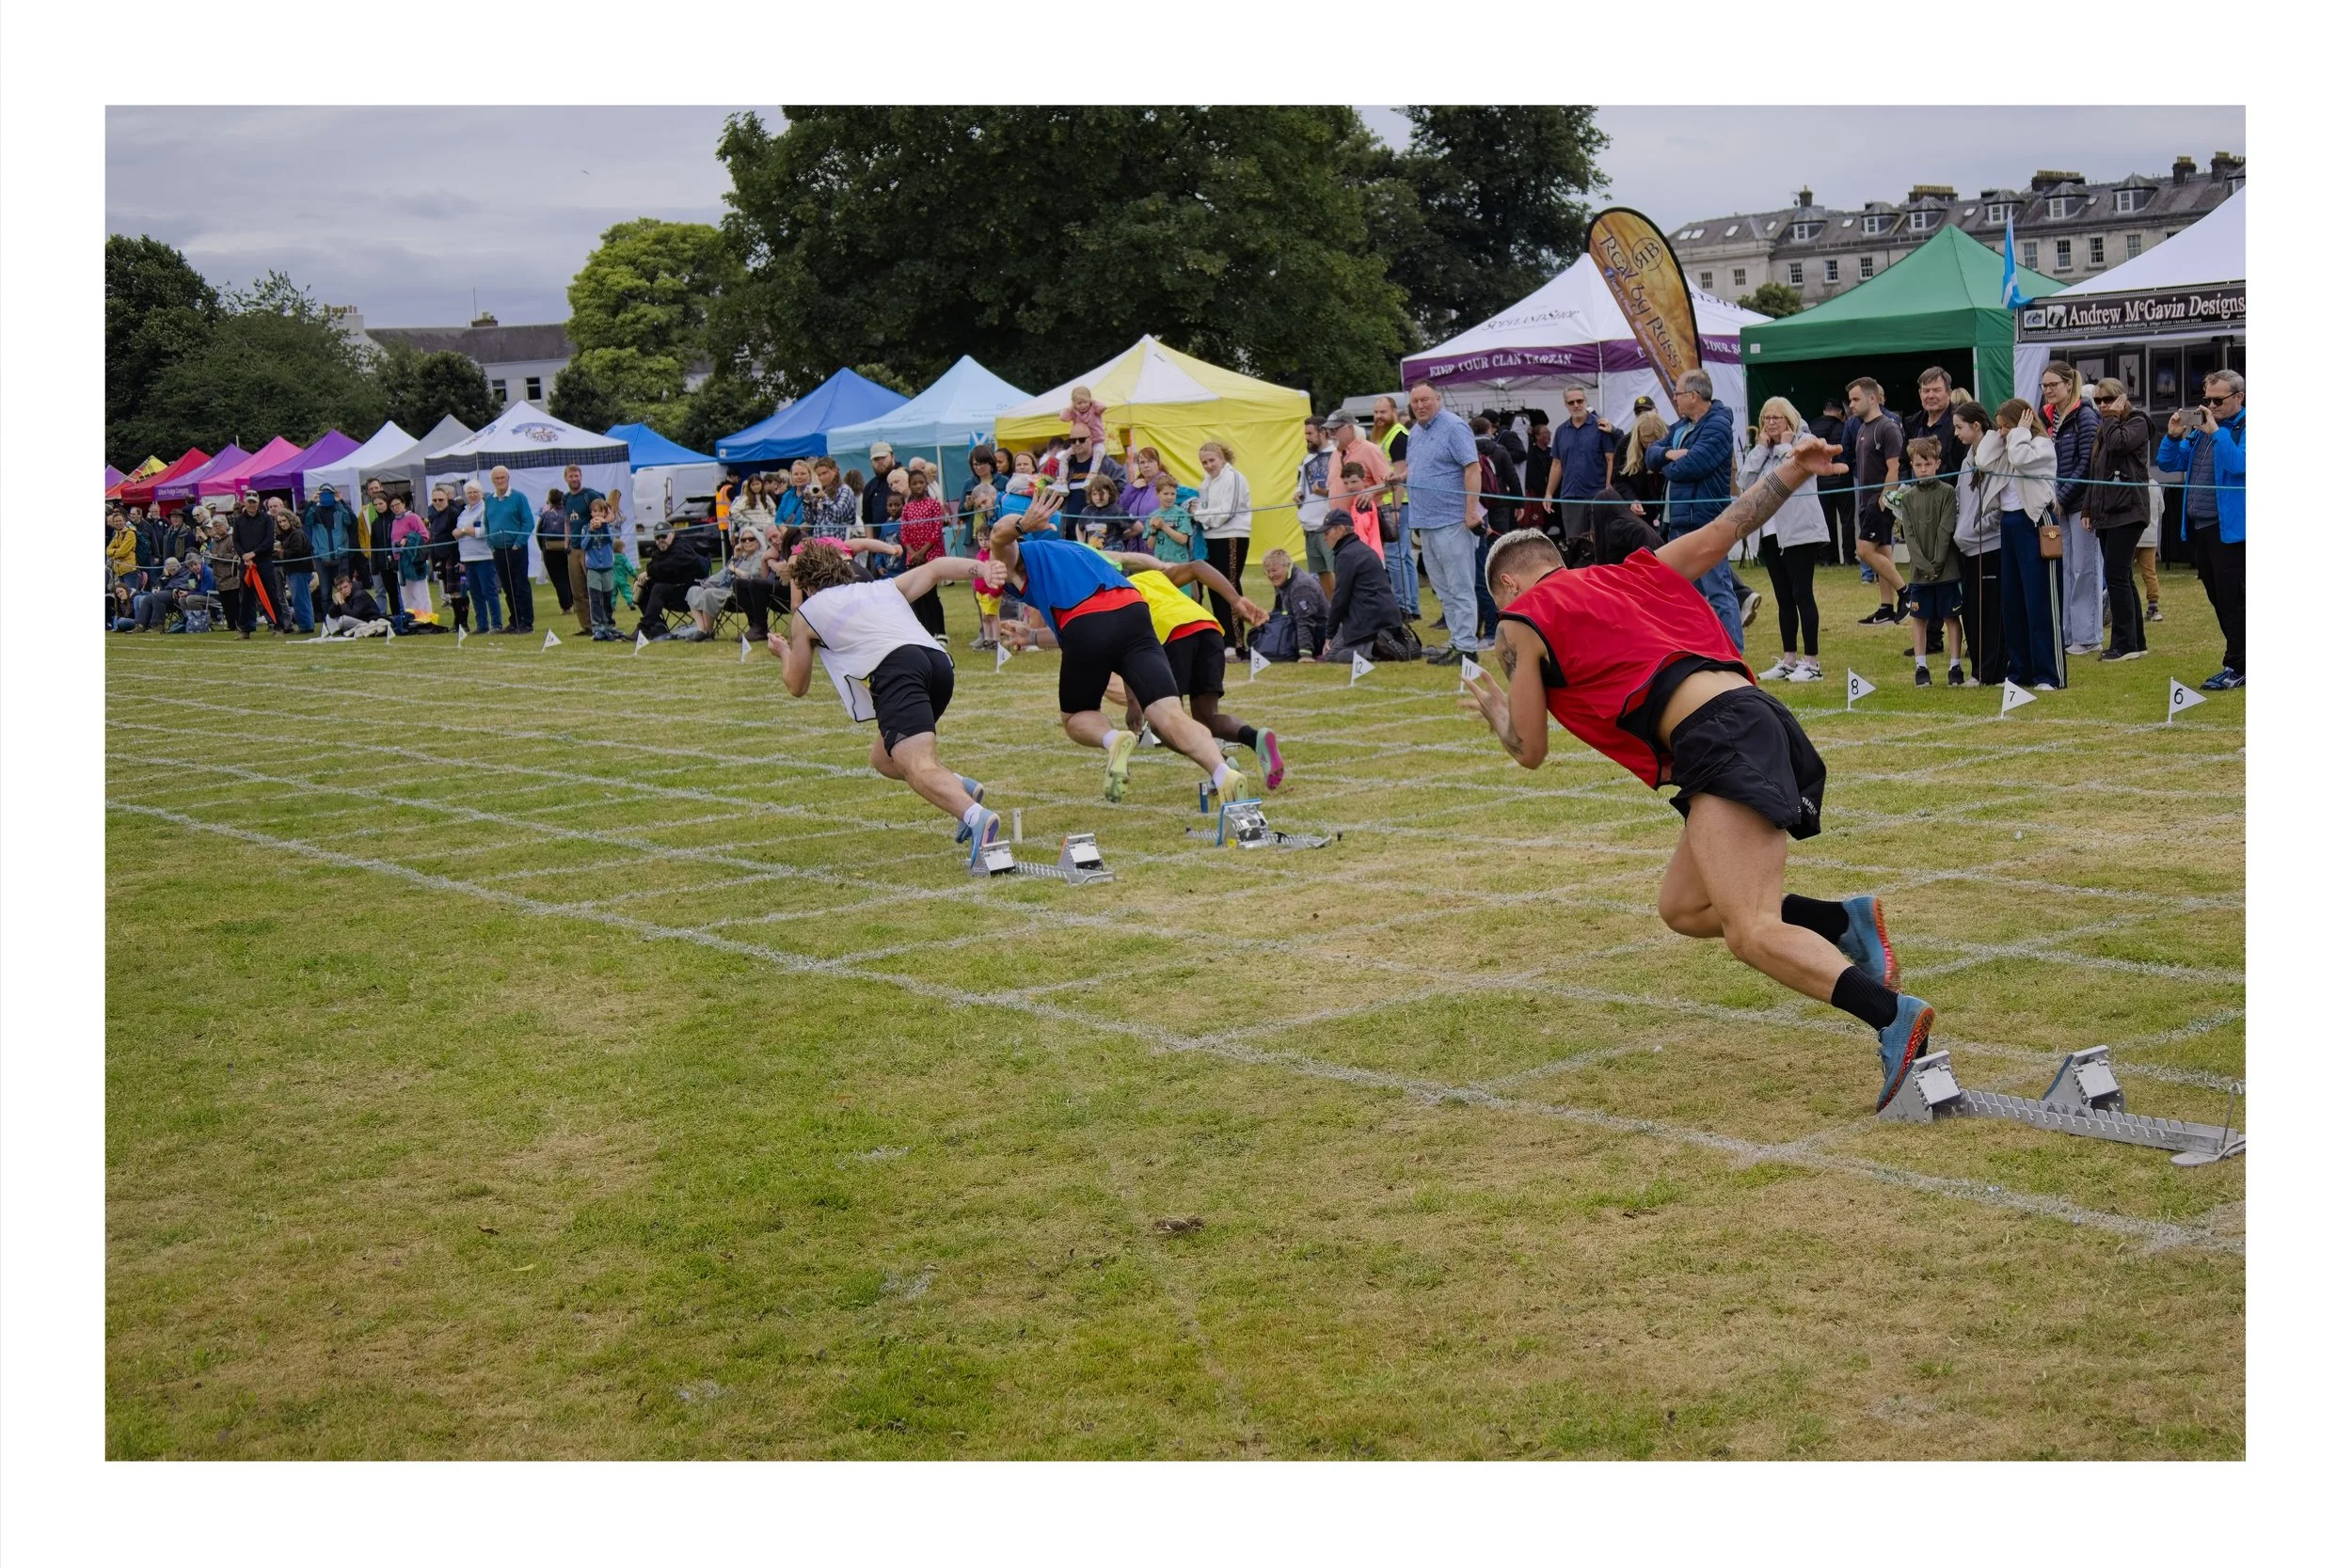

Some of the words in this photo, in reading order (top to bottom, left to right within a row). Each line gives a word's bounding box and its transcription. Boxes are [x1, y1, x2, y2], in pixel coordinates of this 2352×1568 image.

[1599, 233, 1639, 283] Real
[1630, 285, 1651, 316] by
[1645, 316, 1682, 369] Russ
[2069, 303, 2122, 325] Andrew
[2124, 296, 2185, 322] McGavin
[2188, 293, 2246, 319] Designs
[1703, 339, 1732, 353] YOUR
[1429, 365, 1454, 376] FIND
[1458, 356, 1489, 372] YOUR
[1492, 354, 1521, 367] CLAN
[1355, 661, 1363, 673] 12
[1465, 665, 1471, 677] 11
[1851, 678, 1859, 695] 8
[2010, 690, 2016, 703] 7
[2173, 688, 2184, 705] 6
